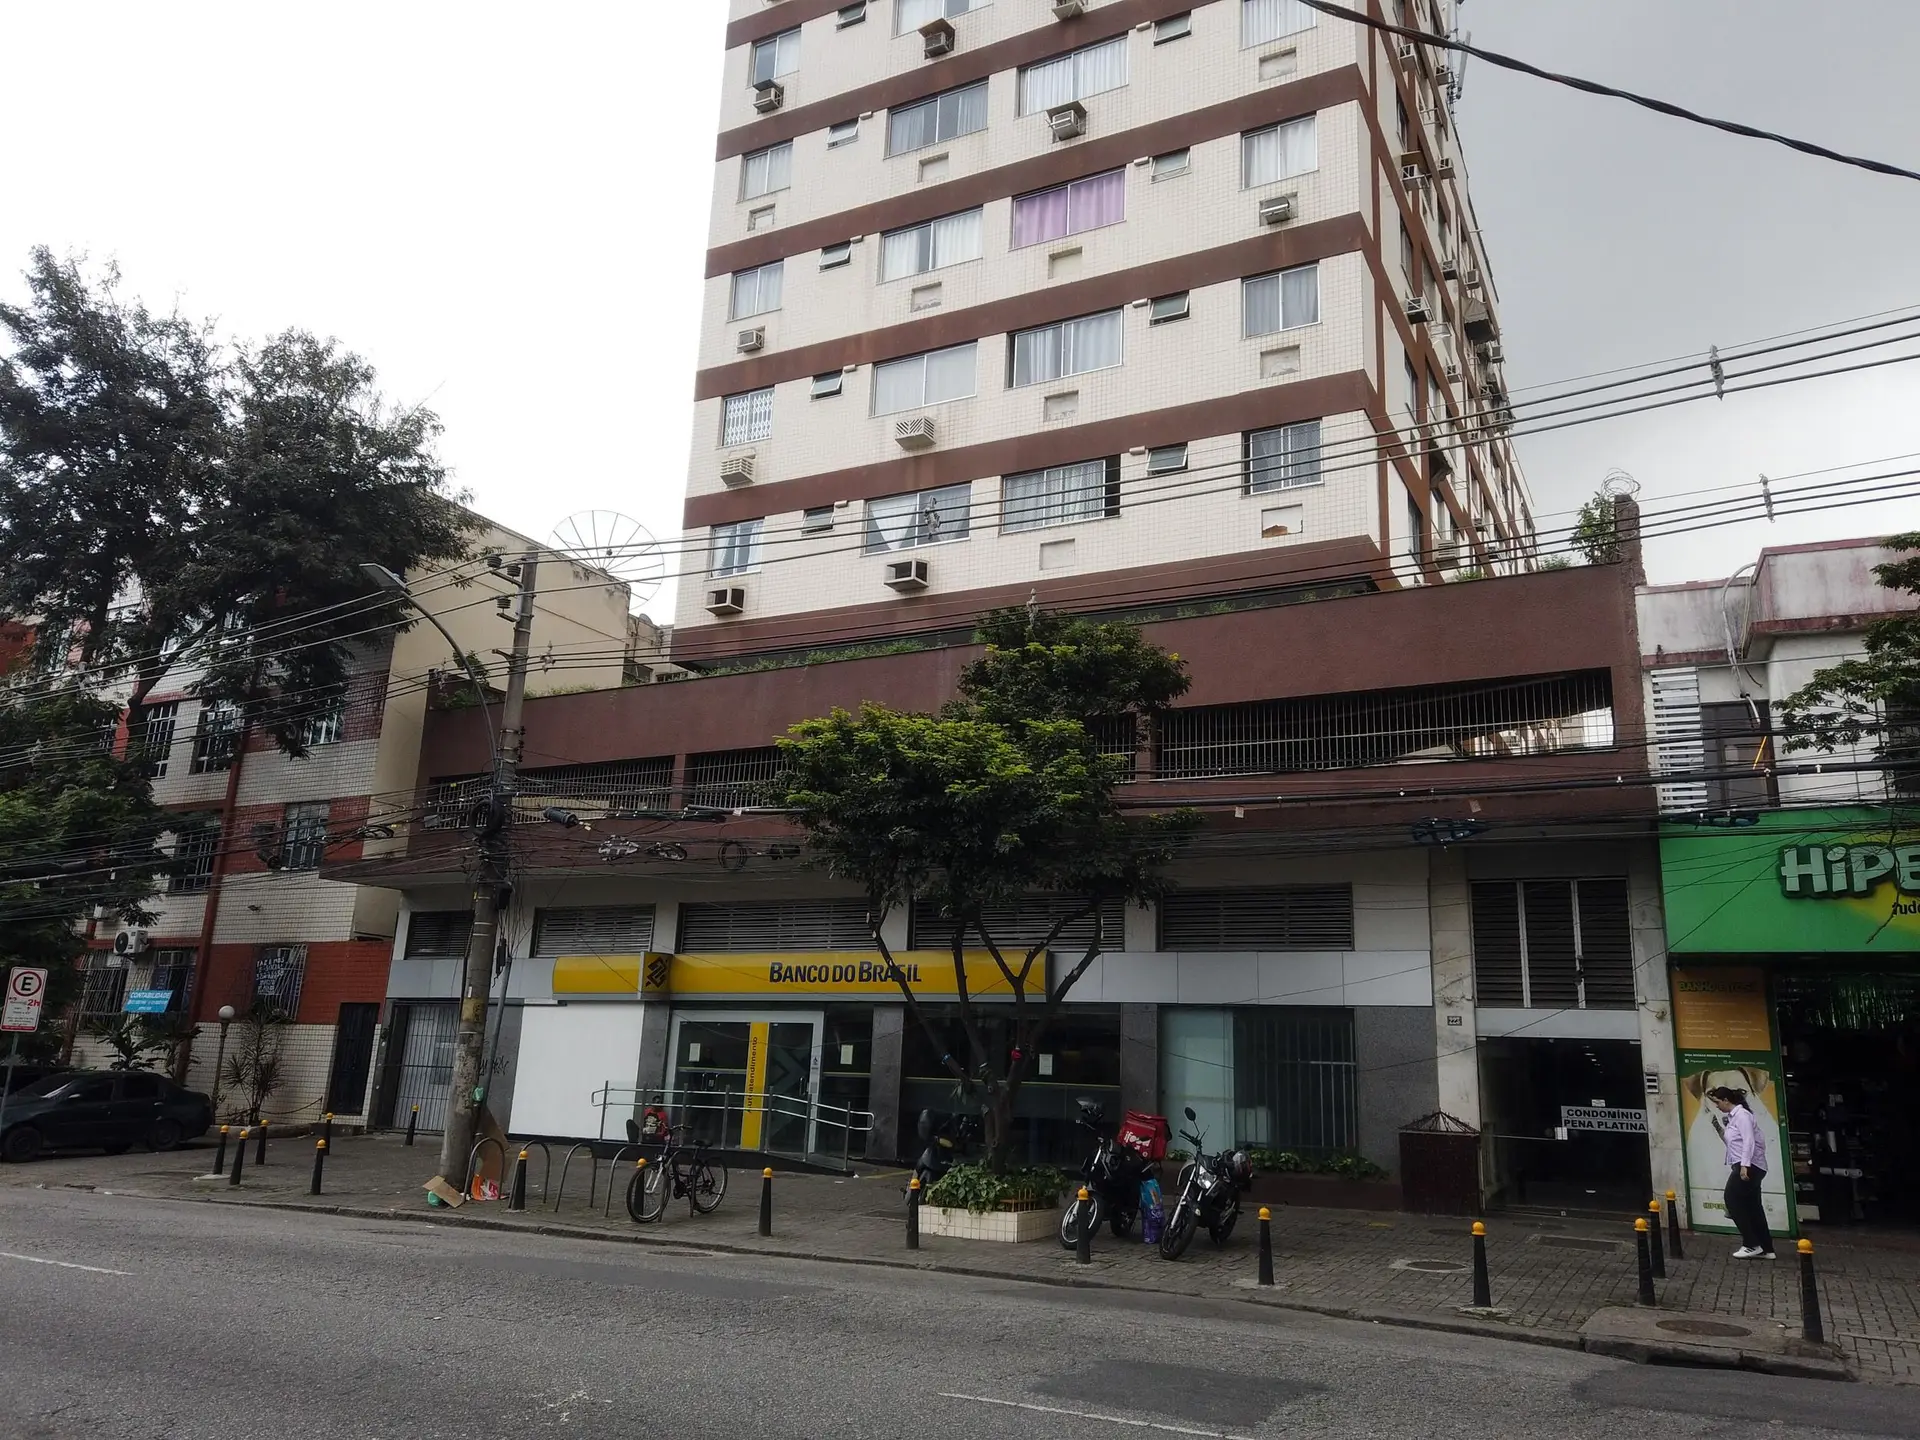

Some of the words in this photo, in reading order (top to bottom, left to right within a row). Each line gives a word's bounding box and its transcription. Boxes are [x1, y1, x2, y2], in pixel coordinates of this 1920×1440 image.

[769, 962, 829, 983] BANCO
[832, 964, 855, 982] DO
[21, 976, 34, 991] E
[27, 999, 41, 1007] 2h
[1567, 1109, 1642, 1120] CONDOMÍNIO
[1564, 1119, 1594, 1129] PENA
[1597, 1121, 1646, 1131] PLATINA
